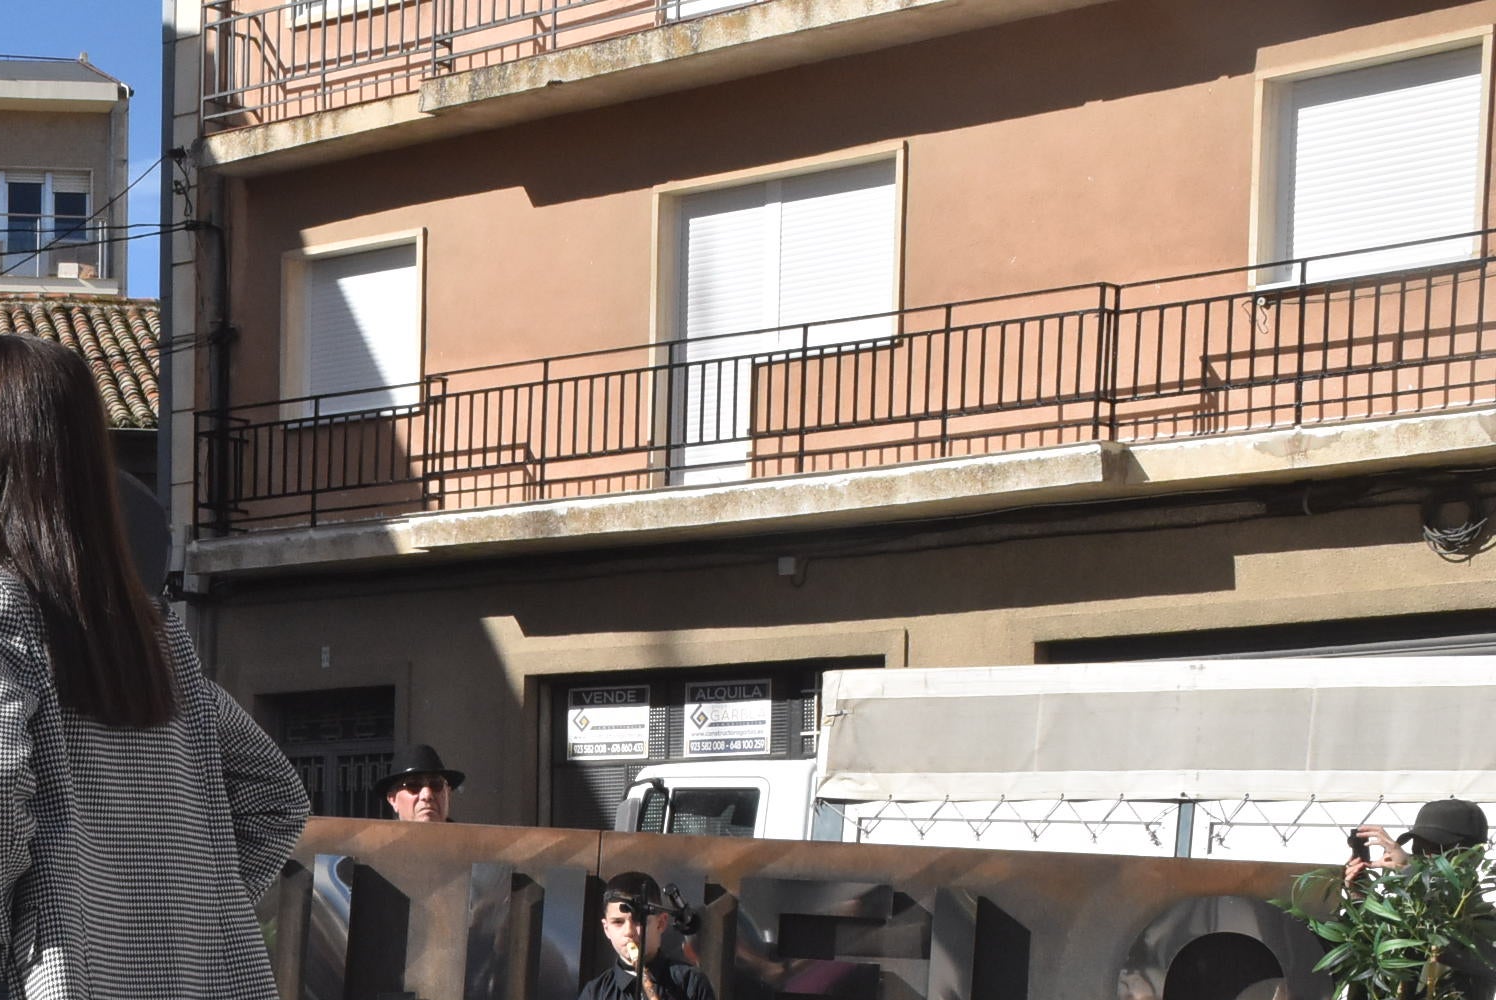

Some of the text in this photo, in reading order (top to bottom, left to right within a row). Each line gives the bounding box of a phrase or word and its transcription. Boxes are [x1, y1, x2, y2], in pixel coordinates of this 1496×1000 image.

[582, 690, 637, 704] VENDE
[696, 686, 762, 701] ALQUILA
[690, 742, 701, 752] 923
[701, 741, 712, 751] 582
[712, 741, 725, 751] 008
[742, 740, 754, 750] 100
[753, 739, 765, 749] 259
